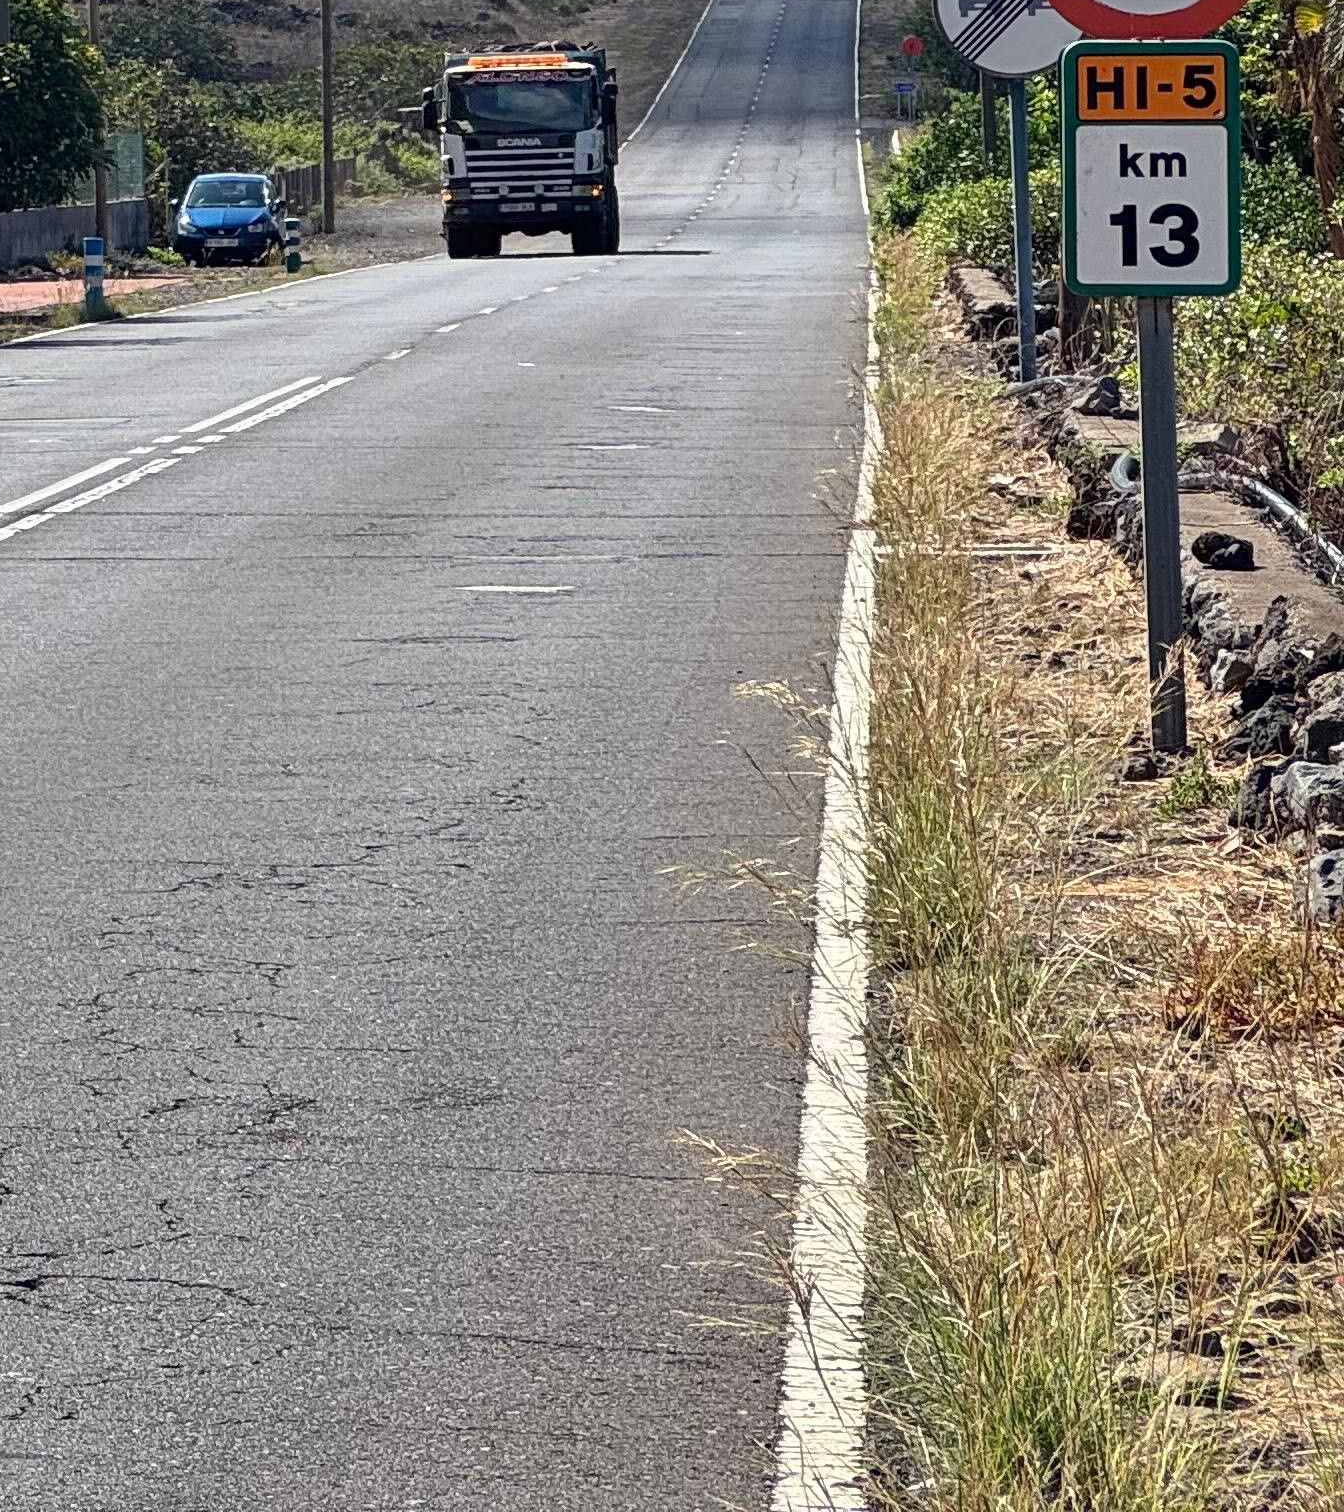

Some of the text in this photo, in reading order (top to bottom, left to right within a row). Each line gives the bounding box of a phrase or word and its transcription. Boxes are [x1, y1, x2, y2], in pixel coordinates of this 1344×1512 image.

[1086, 65, 1218, 110] HI-5
[497, 137, 542, 147] SCANIA
[1120, 144, 1187, 178] km
[1110, 204, 1200, 267] 13
